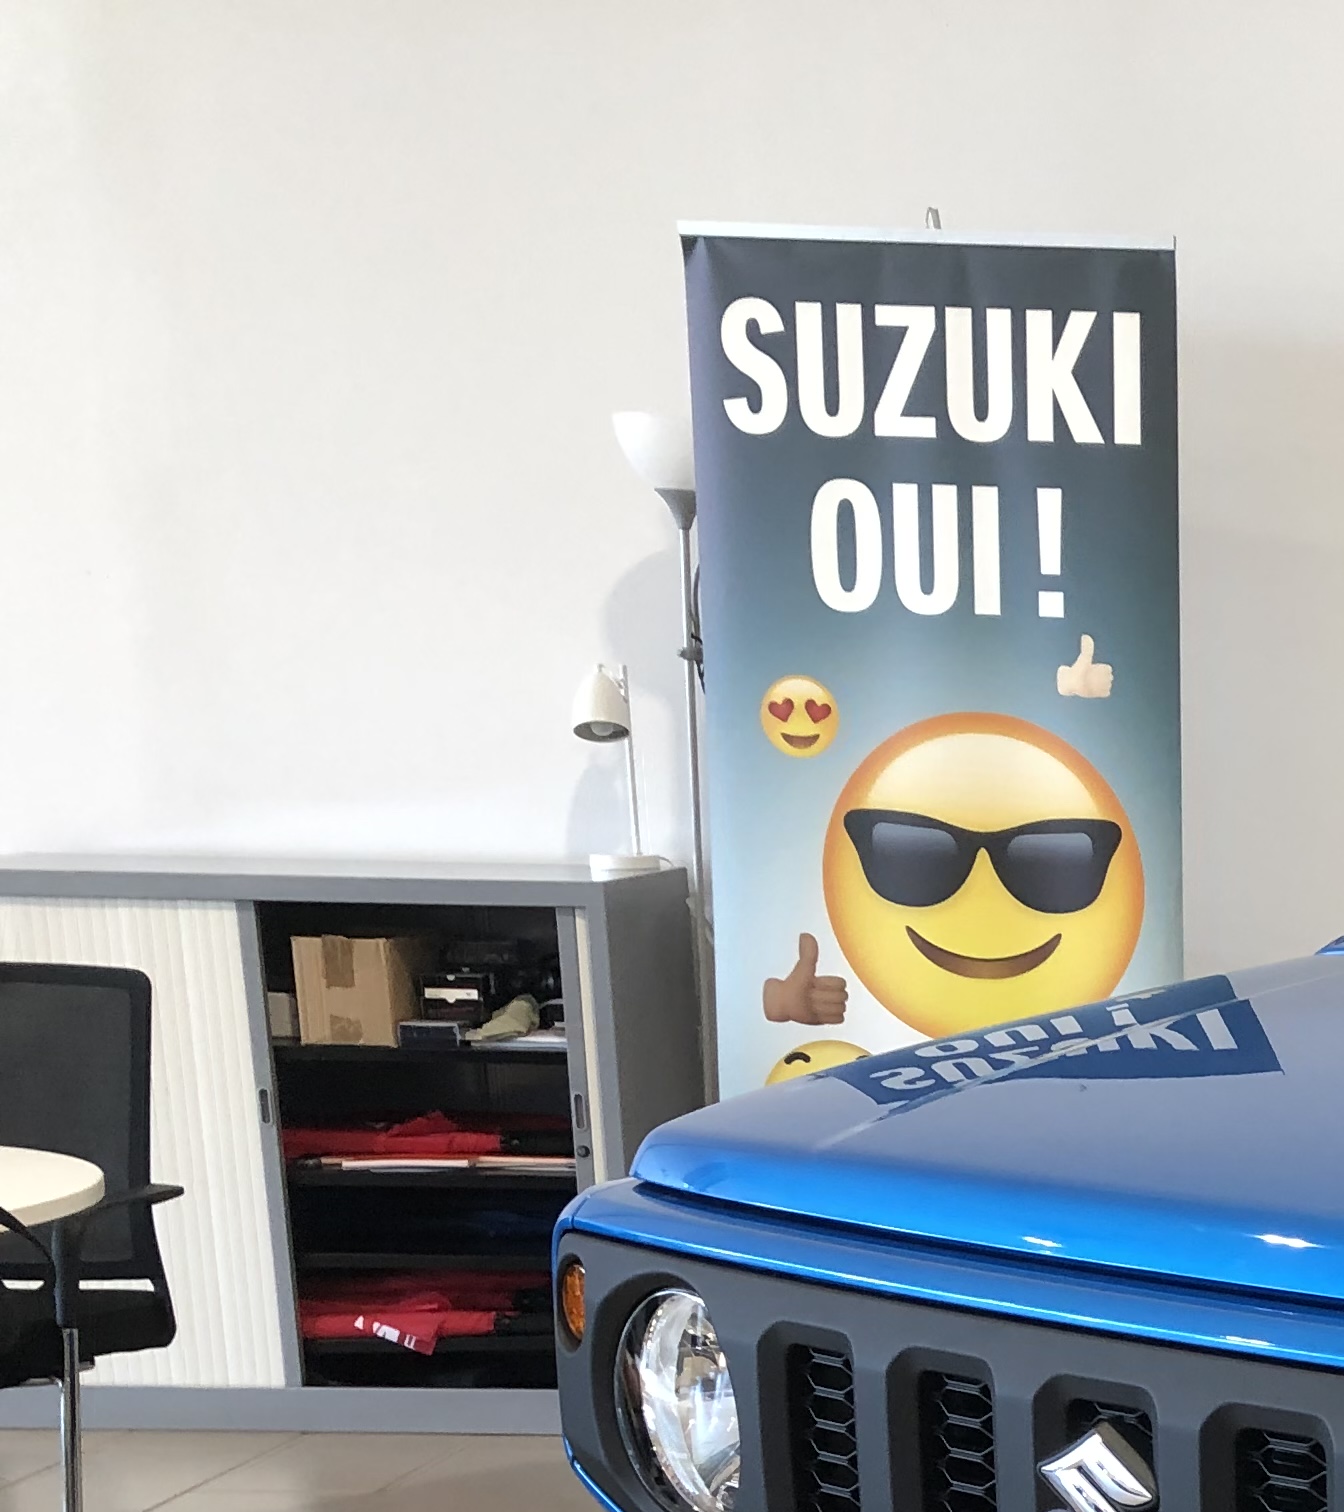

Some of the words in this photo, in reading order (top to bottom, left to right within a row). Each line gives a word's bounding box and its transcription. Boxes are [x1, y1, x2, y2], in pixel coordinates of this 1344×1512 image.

[720, 296, 1142, 446] SUZUKI
[810, 477, 1002, 616] OUI
[1036, 486, 1065, 619] !
